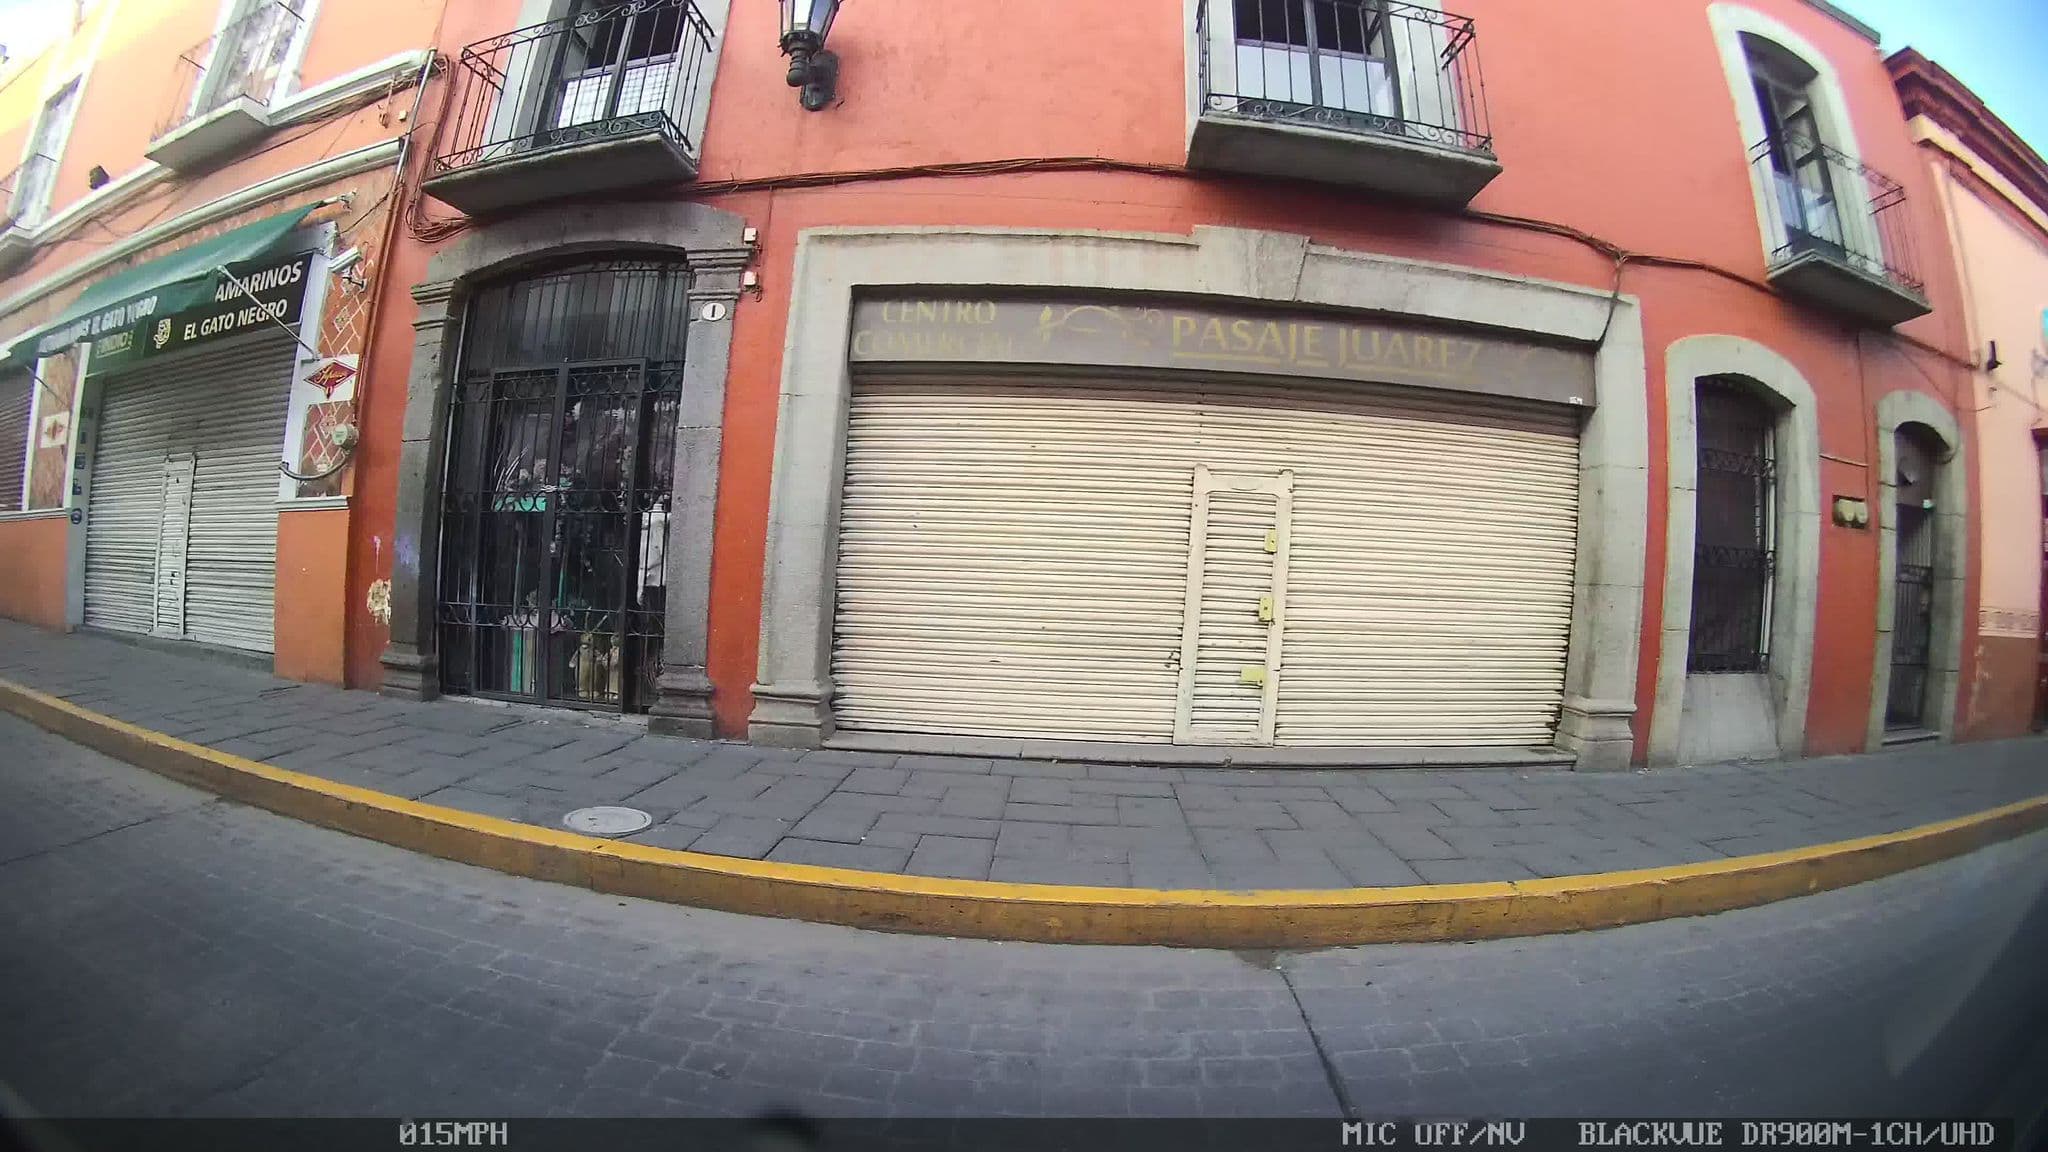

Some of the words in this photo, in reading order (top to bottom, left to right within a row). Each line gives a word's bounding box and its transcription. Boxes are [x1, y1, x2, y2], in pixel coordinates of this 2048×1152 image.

[183, 322, 197, 341] EL
[200, 312, 235, 336] GATO
[237, 298, 288, 328] NEGRO
[882, 301, 997, 325] CENTRO
[1172, 315, 1325, 362] PASAJE
